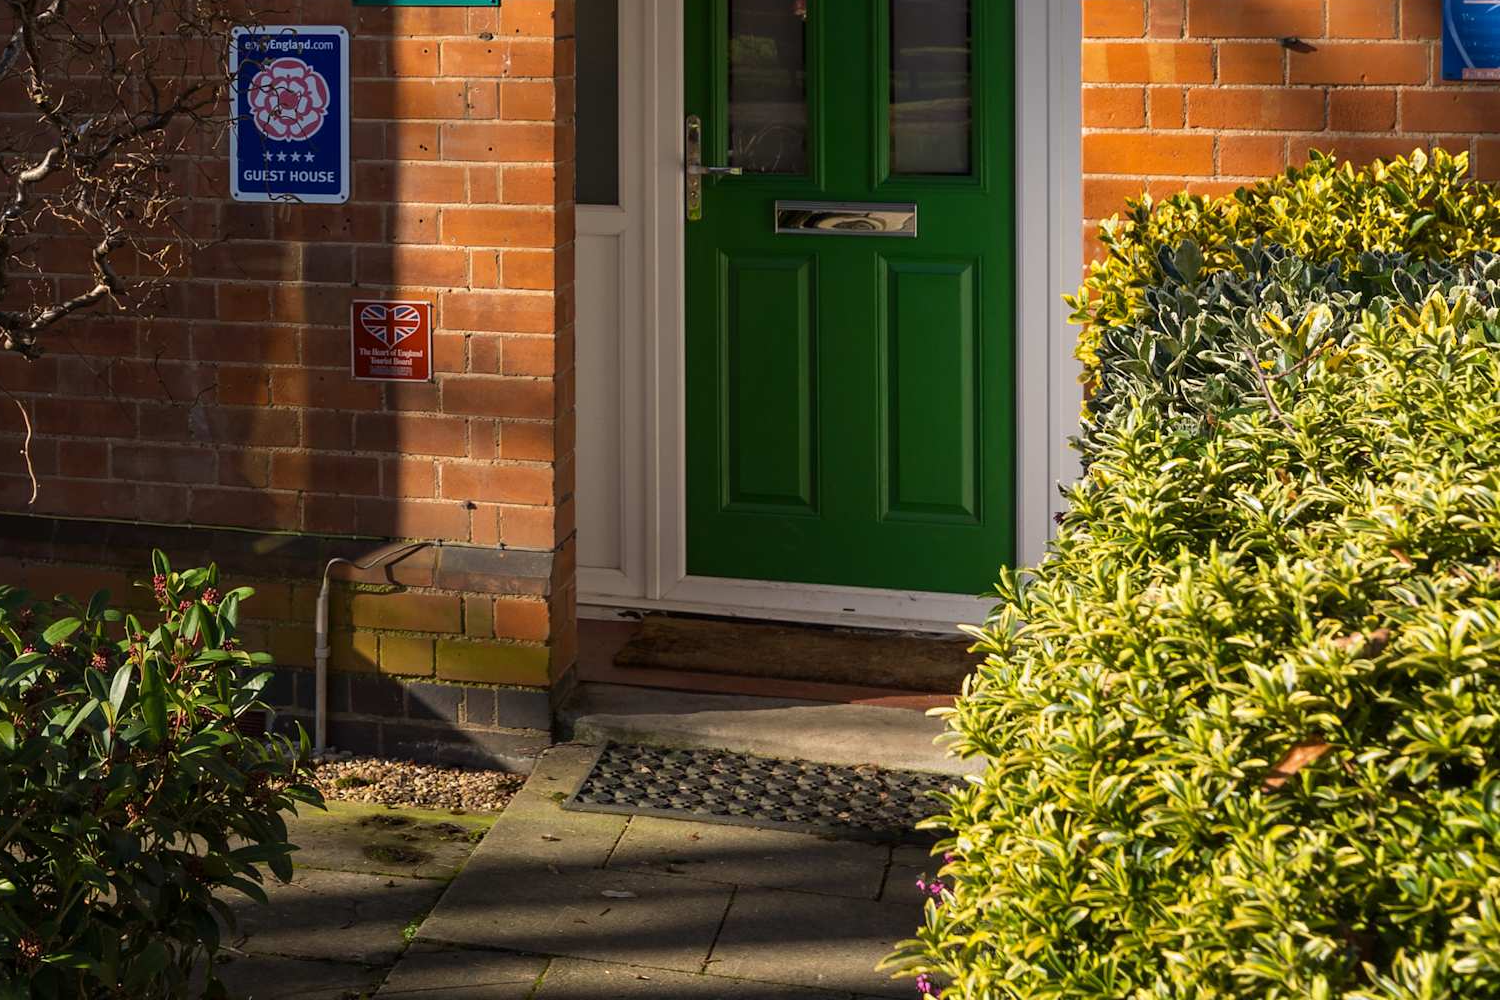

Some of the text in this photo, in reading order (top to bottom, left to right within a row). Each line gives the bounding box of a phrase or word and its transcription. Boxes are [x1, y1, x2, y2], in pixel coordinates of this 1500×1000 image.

[243, 170, 335, 183] GUEST HOUSE
[359, 347, 423, 359] The Heart of England
[371, 356, 413, 366] Tourist Board
